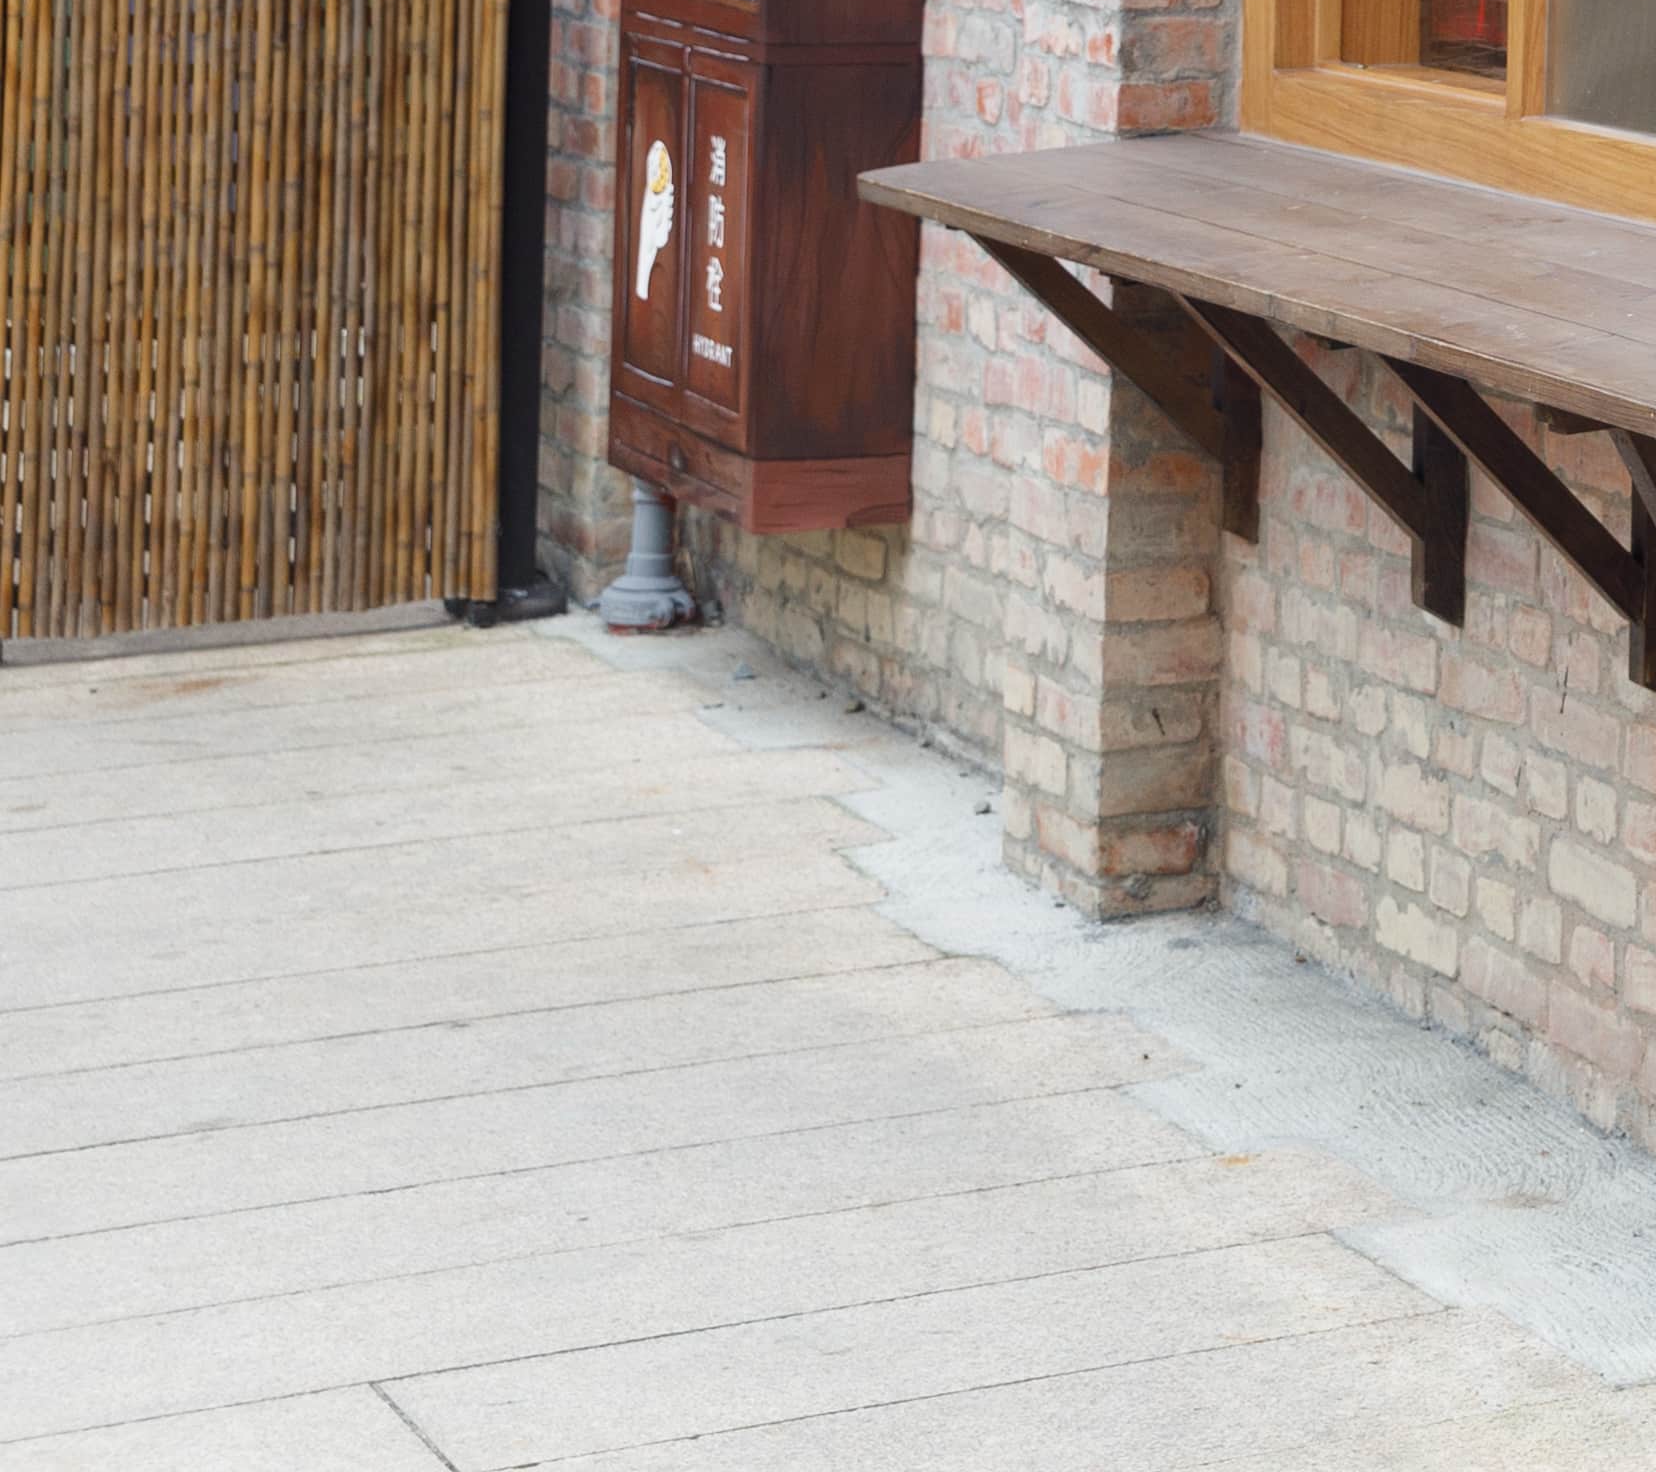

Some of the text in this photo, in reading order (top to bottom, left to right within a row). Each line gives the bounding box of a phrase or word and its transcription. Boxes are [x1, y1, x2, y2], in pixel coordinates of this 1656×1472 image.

[706, 134, 727, 312] 消防栓
[692, 332, 733, 368] HYDRANT
